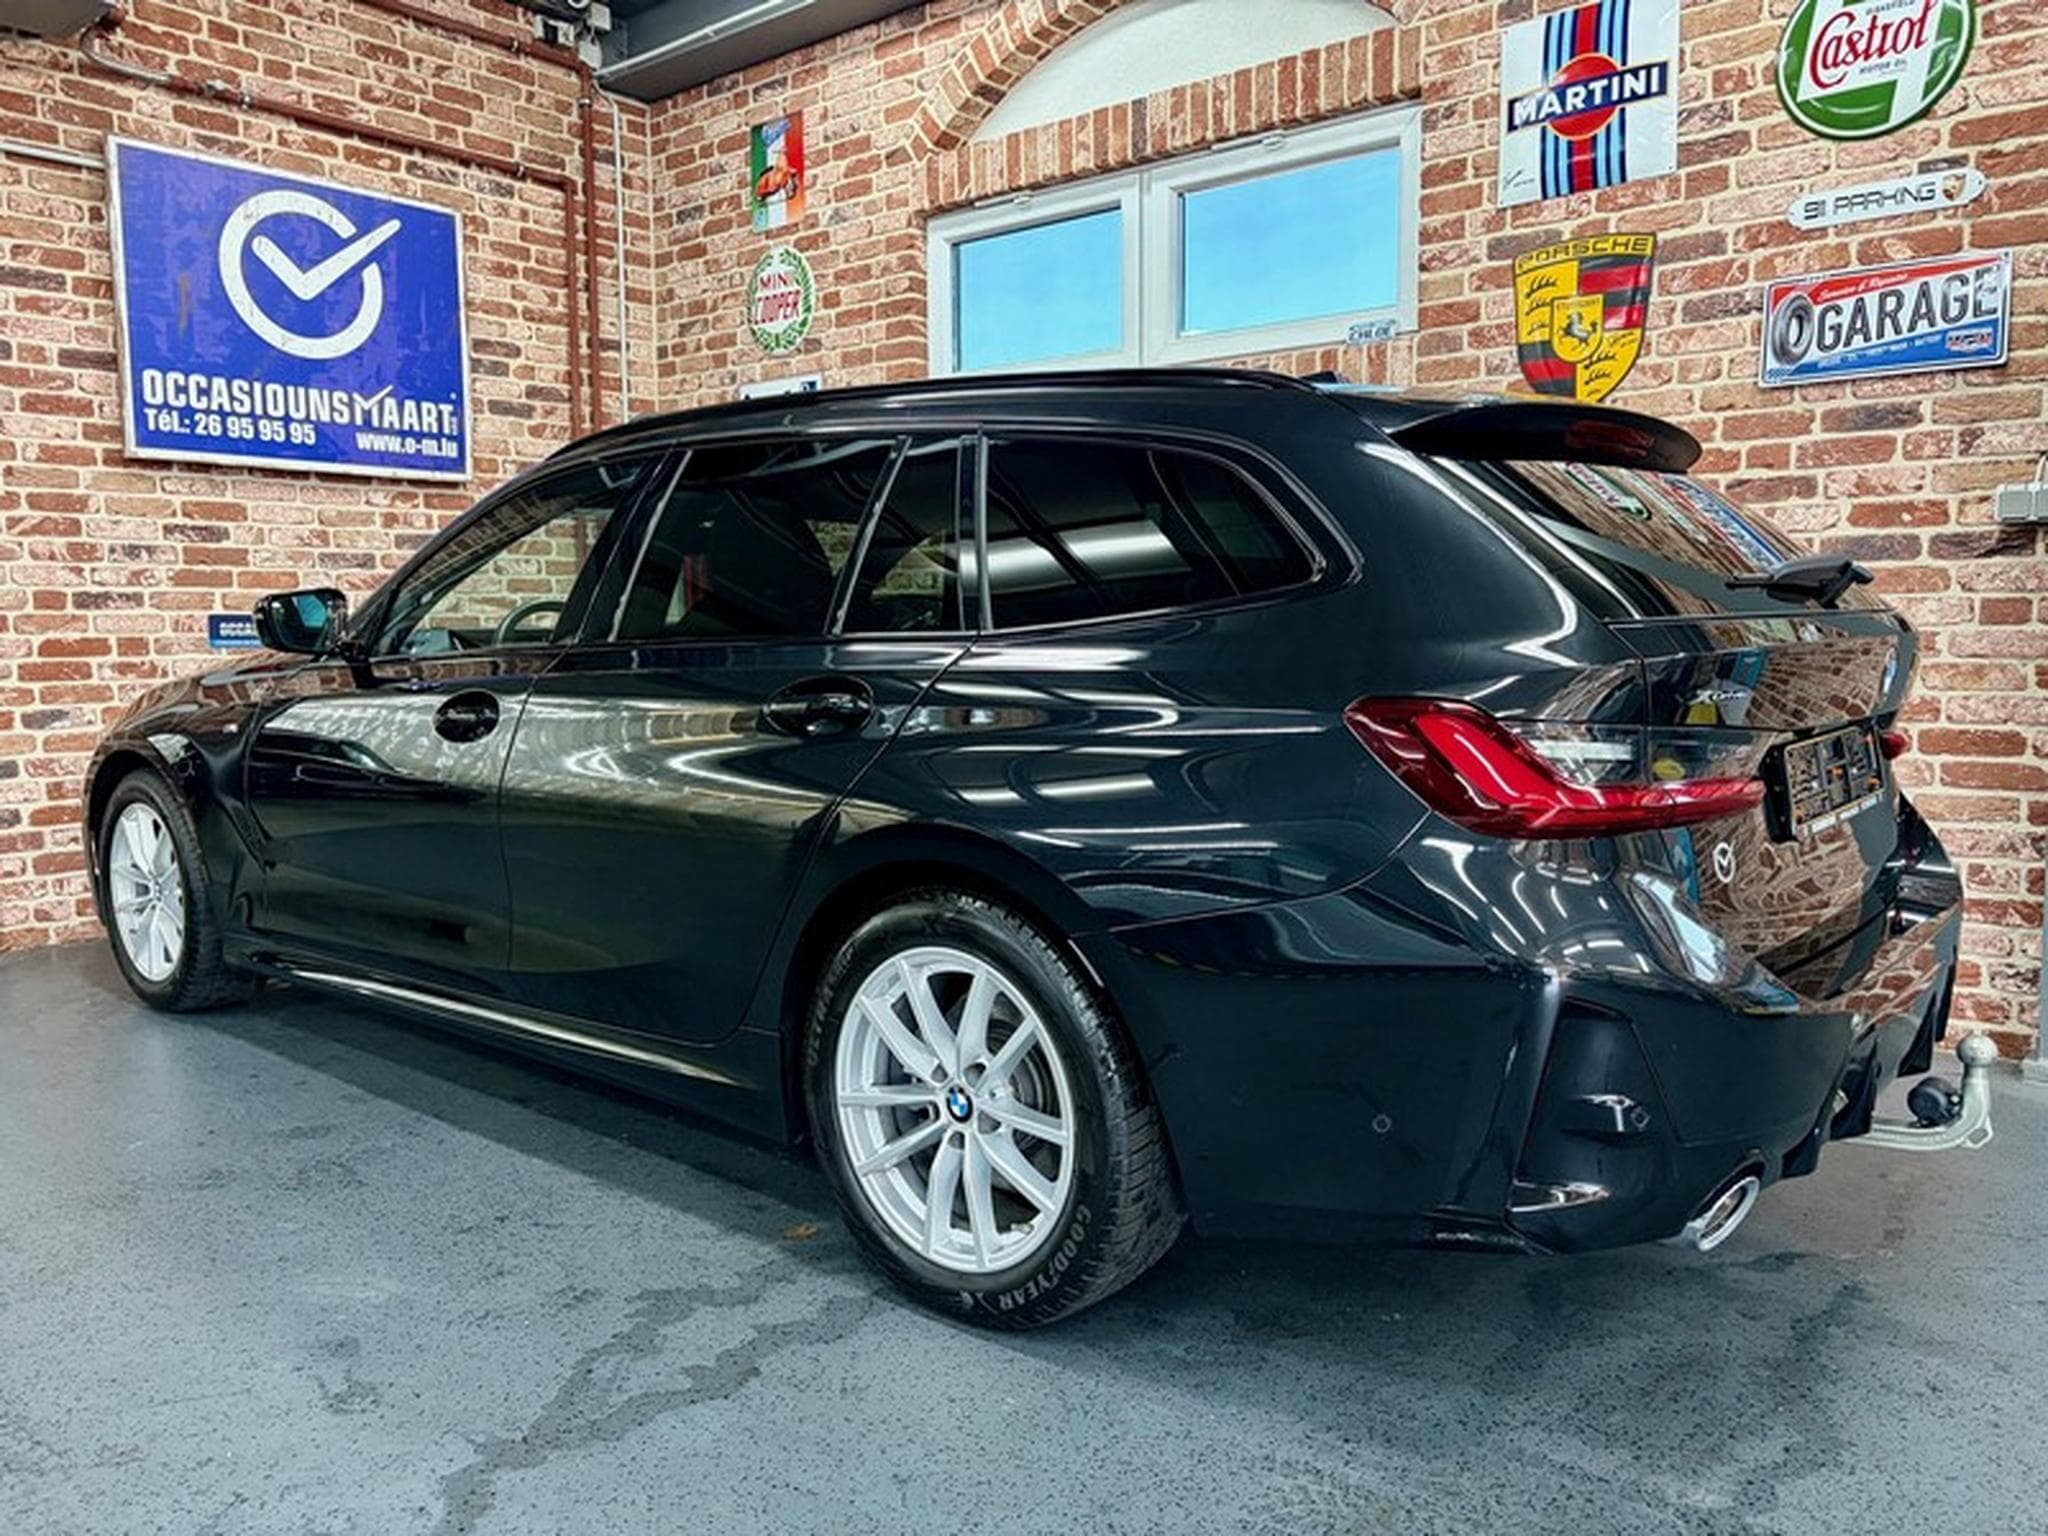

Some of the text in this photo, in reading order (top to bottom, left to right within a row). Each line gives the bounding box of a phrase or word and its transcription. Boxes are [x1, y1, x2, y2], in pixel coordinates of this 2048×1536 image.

[1810, 0, 1938, 90] Castrol
[1513, 66, 1660, 127] MARTINI
[1833, 181, 1937, 215] PARKING
[1517, 237, 1650, 271] PORSCHE
[753, 289, 800, 325] COOPER
[1816, 265, 1999, 353] GARAGE
[194, 412, 222, 437] 26
[226, 415, 254, 440] 95
[258, 418, 286, 443] 95
[289, 421, 316, 446] 95
[355, 431, 458, 458] www.o-m.lu
[999, 1204, 1092, 1310] GOODYEAR
